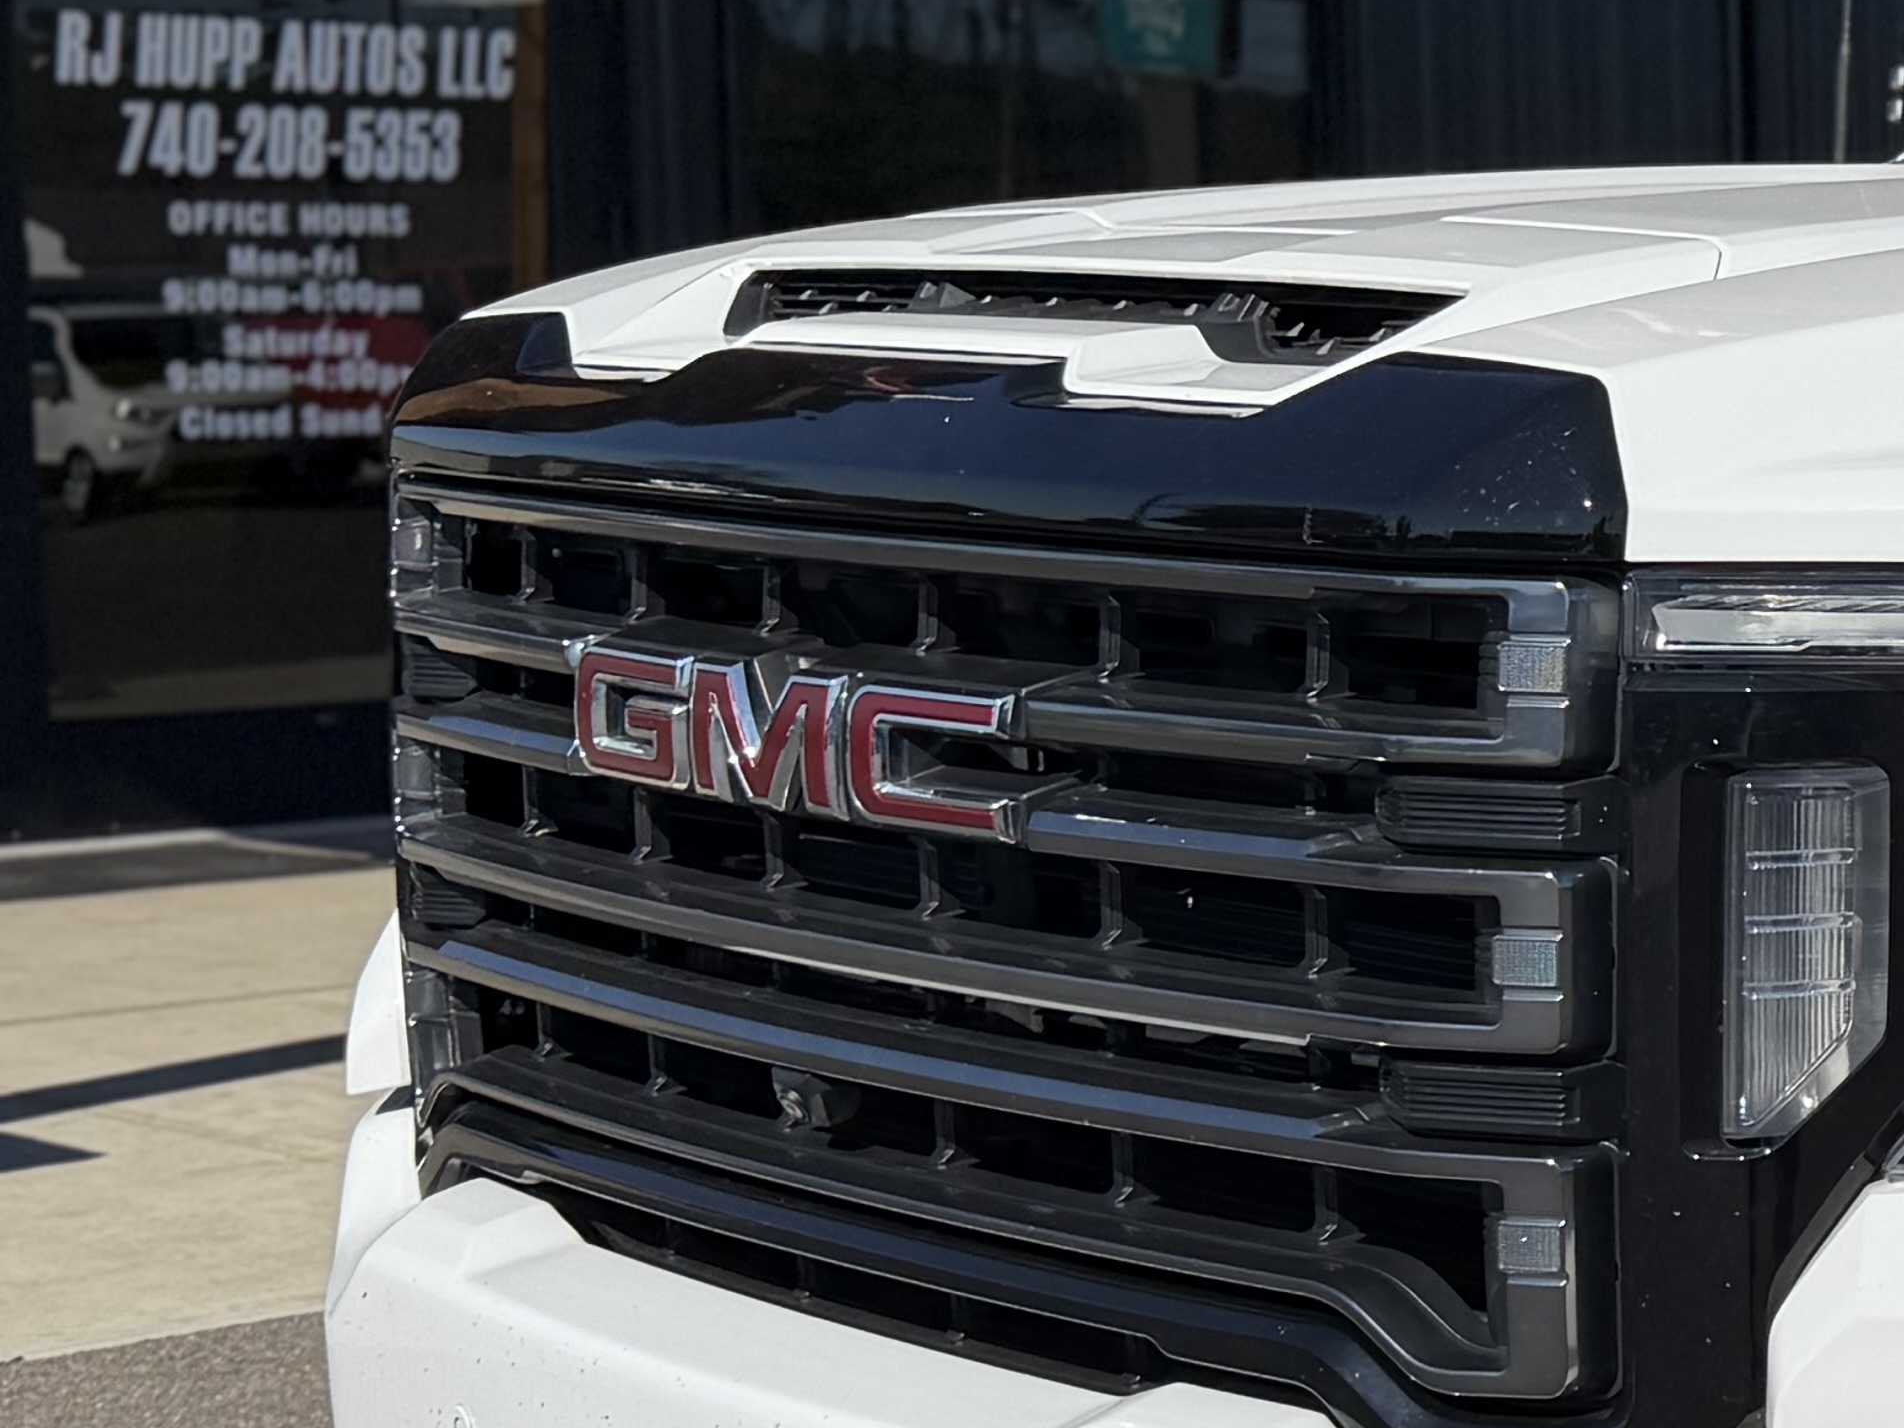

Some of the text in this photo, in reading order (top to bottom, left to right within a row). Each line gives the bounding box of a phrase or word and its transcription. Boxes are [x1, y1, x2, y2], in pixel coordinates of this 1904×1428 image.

[55, 7, 517, 101] RJ HUPP AUTOS LLC
[116, 98, 463, 182] 740-208-5353
[166, 198, 411, 239] OFFICE HOURS
[226, 242, 358, 278] Mon-Fri
[222, 324, 369, 361] Saturday
[177, 402, 386, 441] Closed Sund
[575, 645, 1022, 845] GMC
